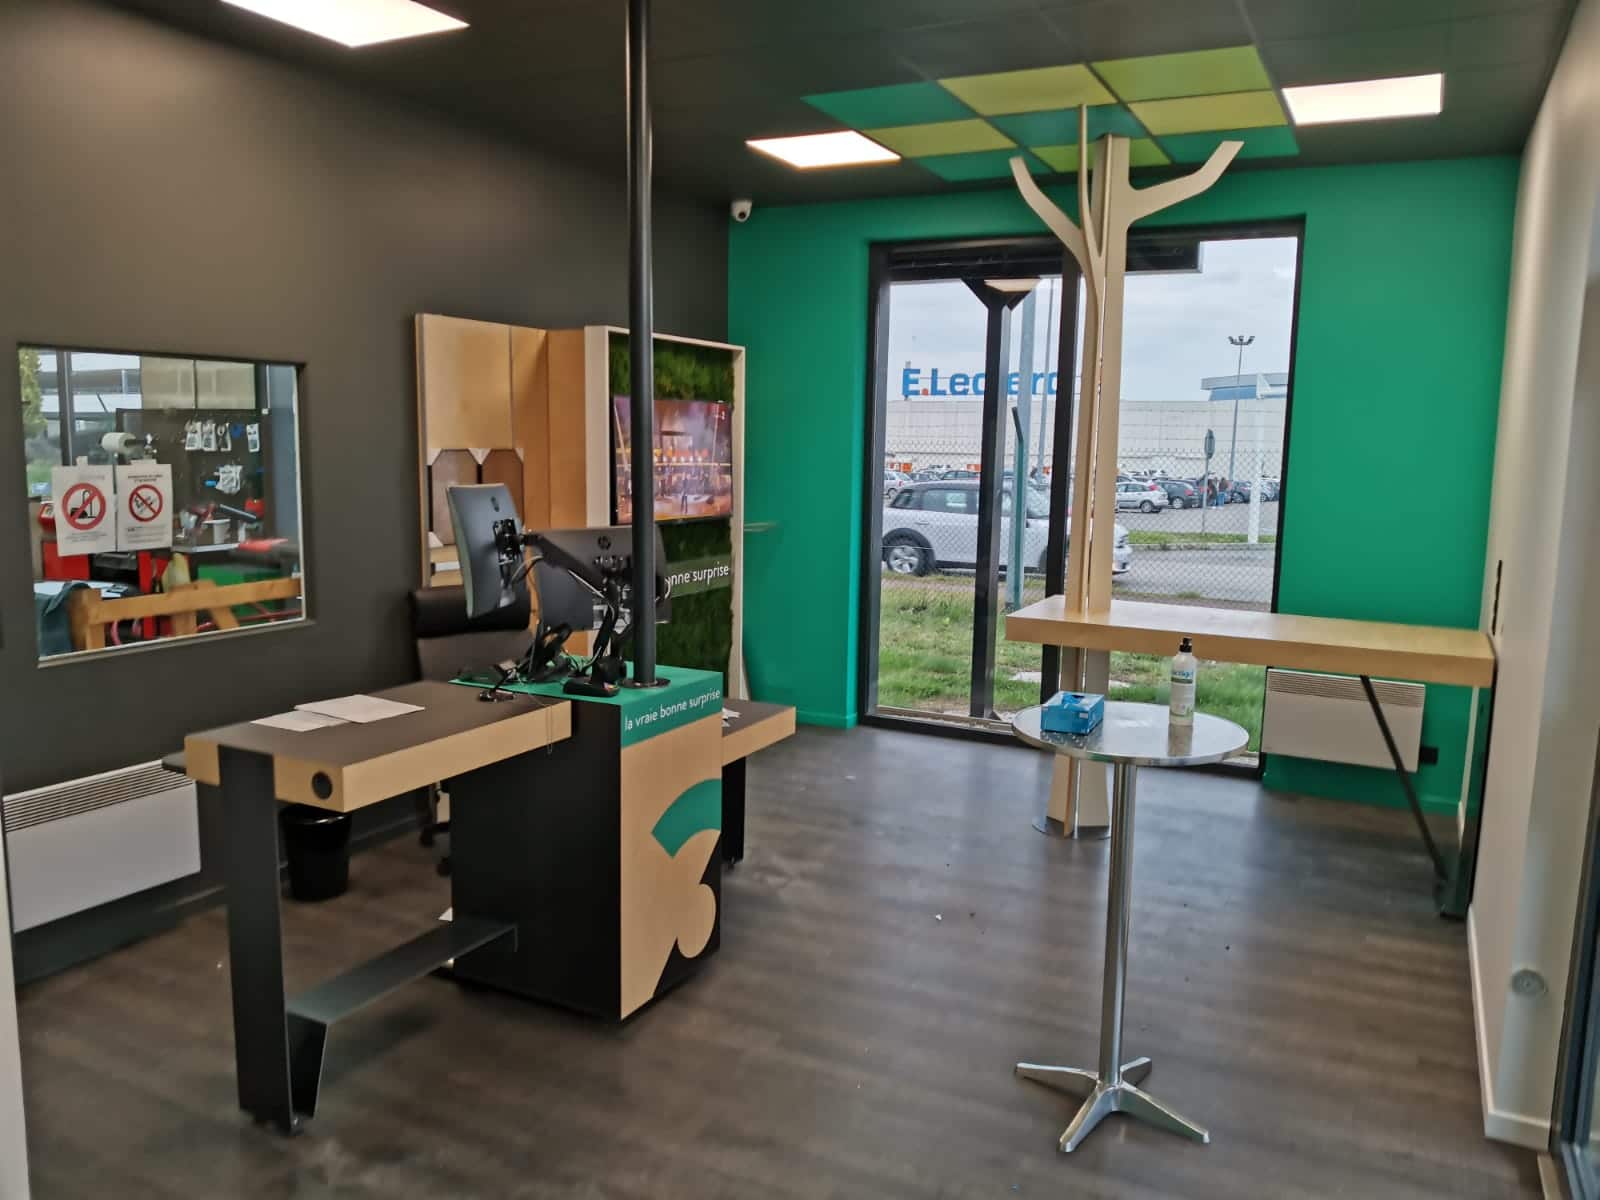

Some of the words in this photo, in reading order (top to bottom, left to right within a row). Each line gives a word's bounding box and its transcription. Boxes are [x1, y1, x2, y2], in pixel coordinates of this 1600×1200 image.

[693, 561, 729, 585] surprise
[624, 715, 633, 731] la
[635, 708, 658, 727] vraie
[660, 702, 687, 718] bonne
[689, 688, 720, 709] surprise
